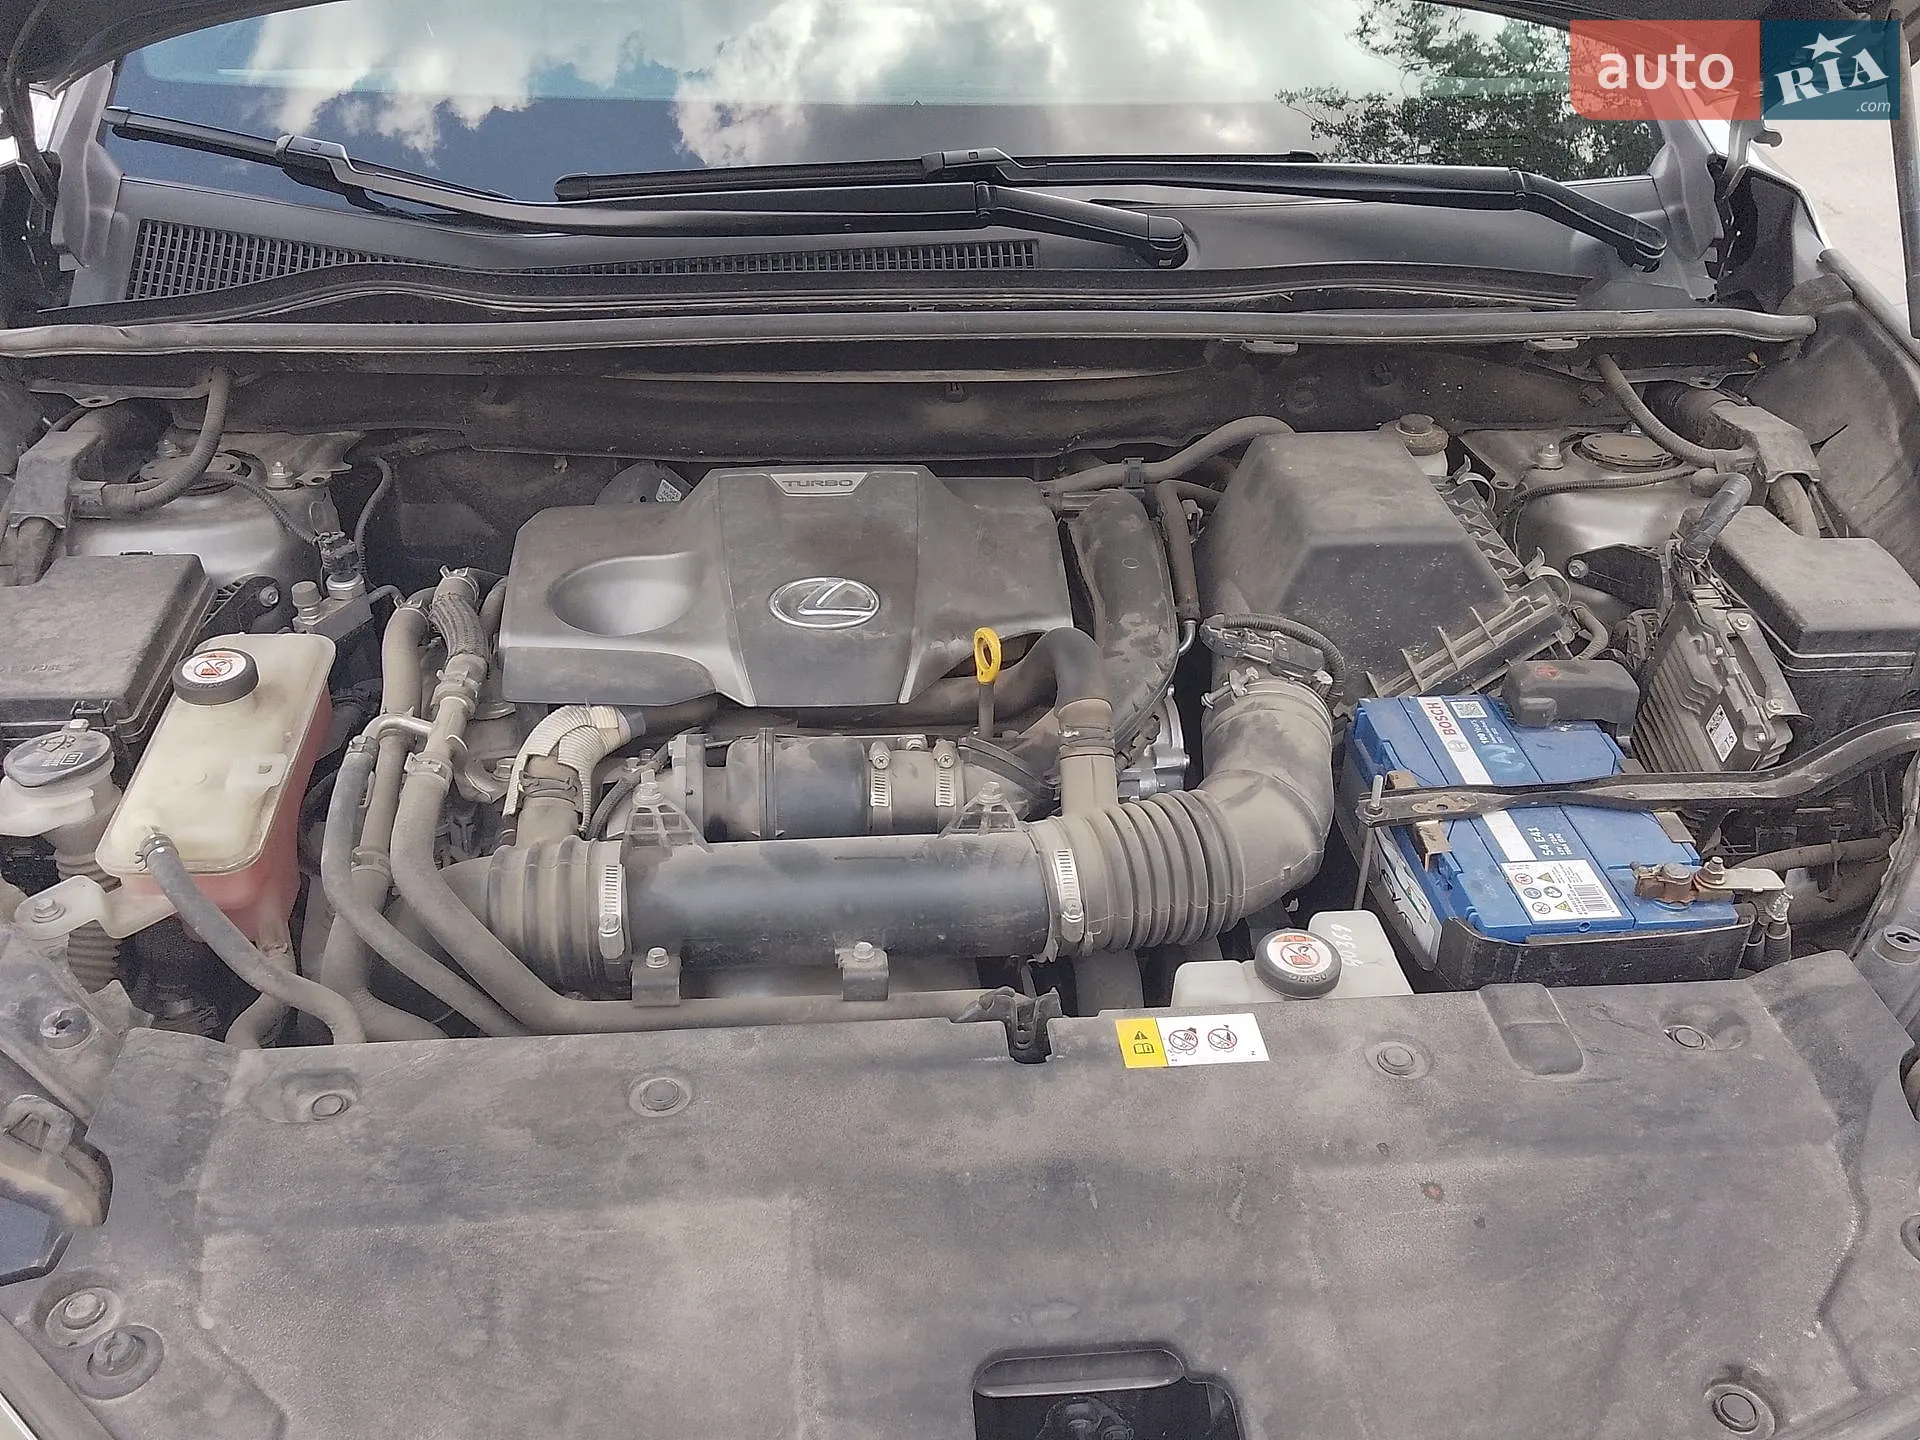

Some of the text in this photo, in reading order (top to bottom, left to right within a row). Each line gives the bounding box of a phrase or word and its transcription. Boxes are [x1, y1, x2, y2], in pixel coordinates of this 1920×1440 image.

[781, 479, 854, 487] TURBO
[1425, 702, 1458, 736] BOSCH
[1287, 973, 1328, 984] DENSO
